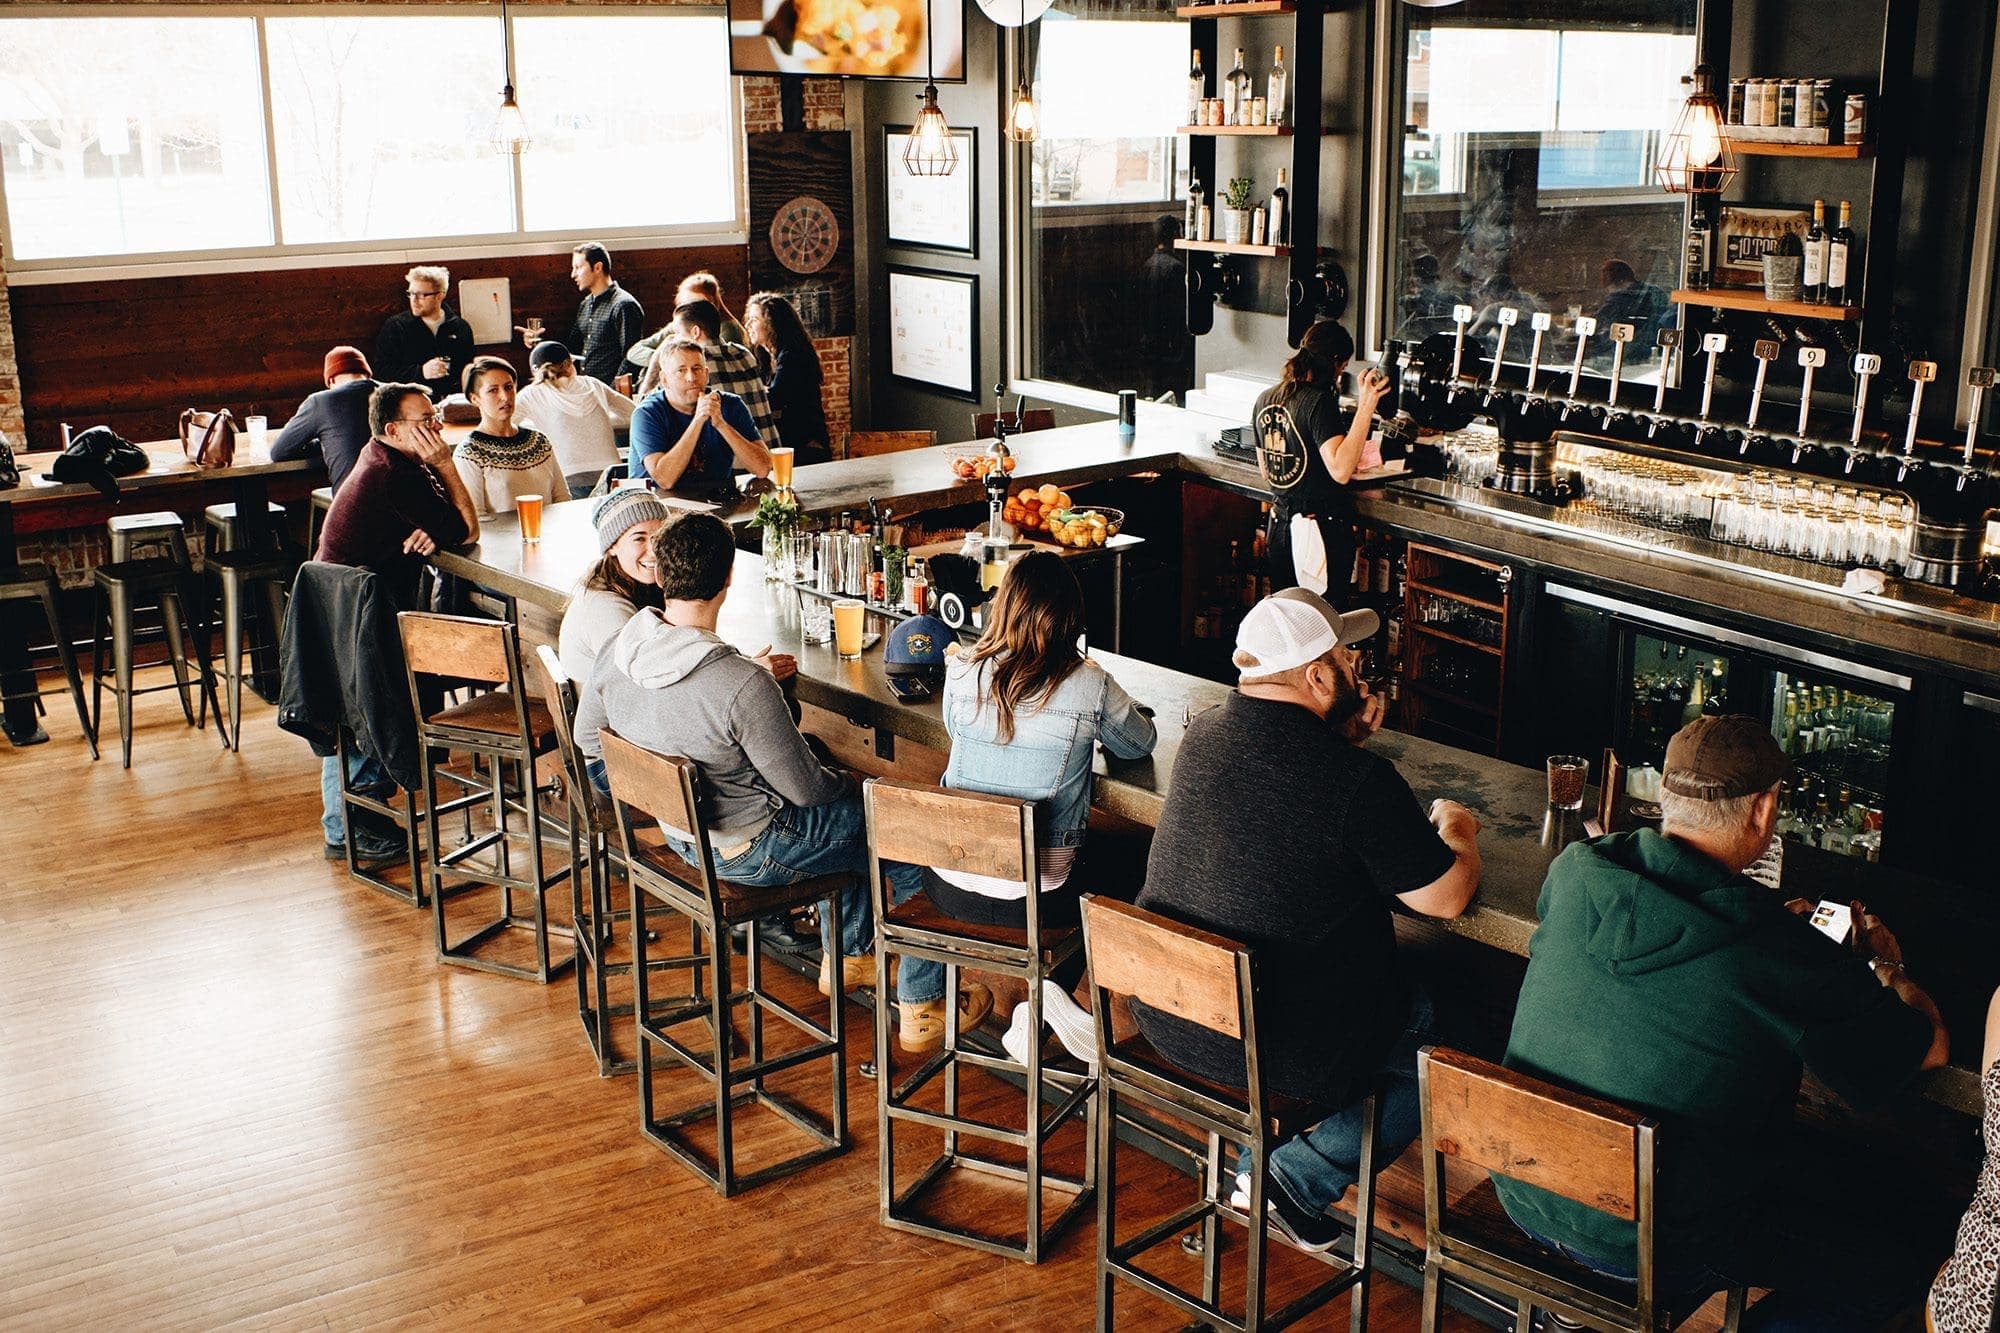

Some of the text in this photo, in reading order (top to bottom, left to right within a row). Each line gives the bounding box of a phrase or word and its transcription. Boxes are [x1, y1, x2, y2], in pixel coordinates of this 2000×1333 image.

[1617, 327, 1626, 339] 5
[1711, 337, 1719, 349] 7
[1762, 343, 1772, 357] 8
[1807, 350, 1817, 363] 9
[1860, 358, 1876, 371] 10
[1914, 365, 1931, 378] 11
